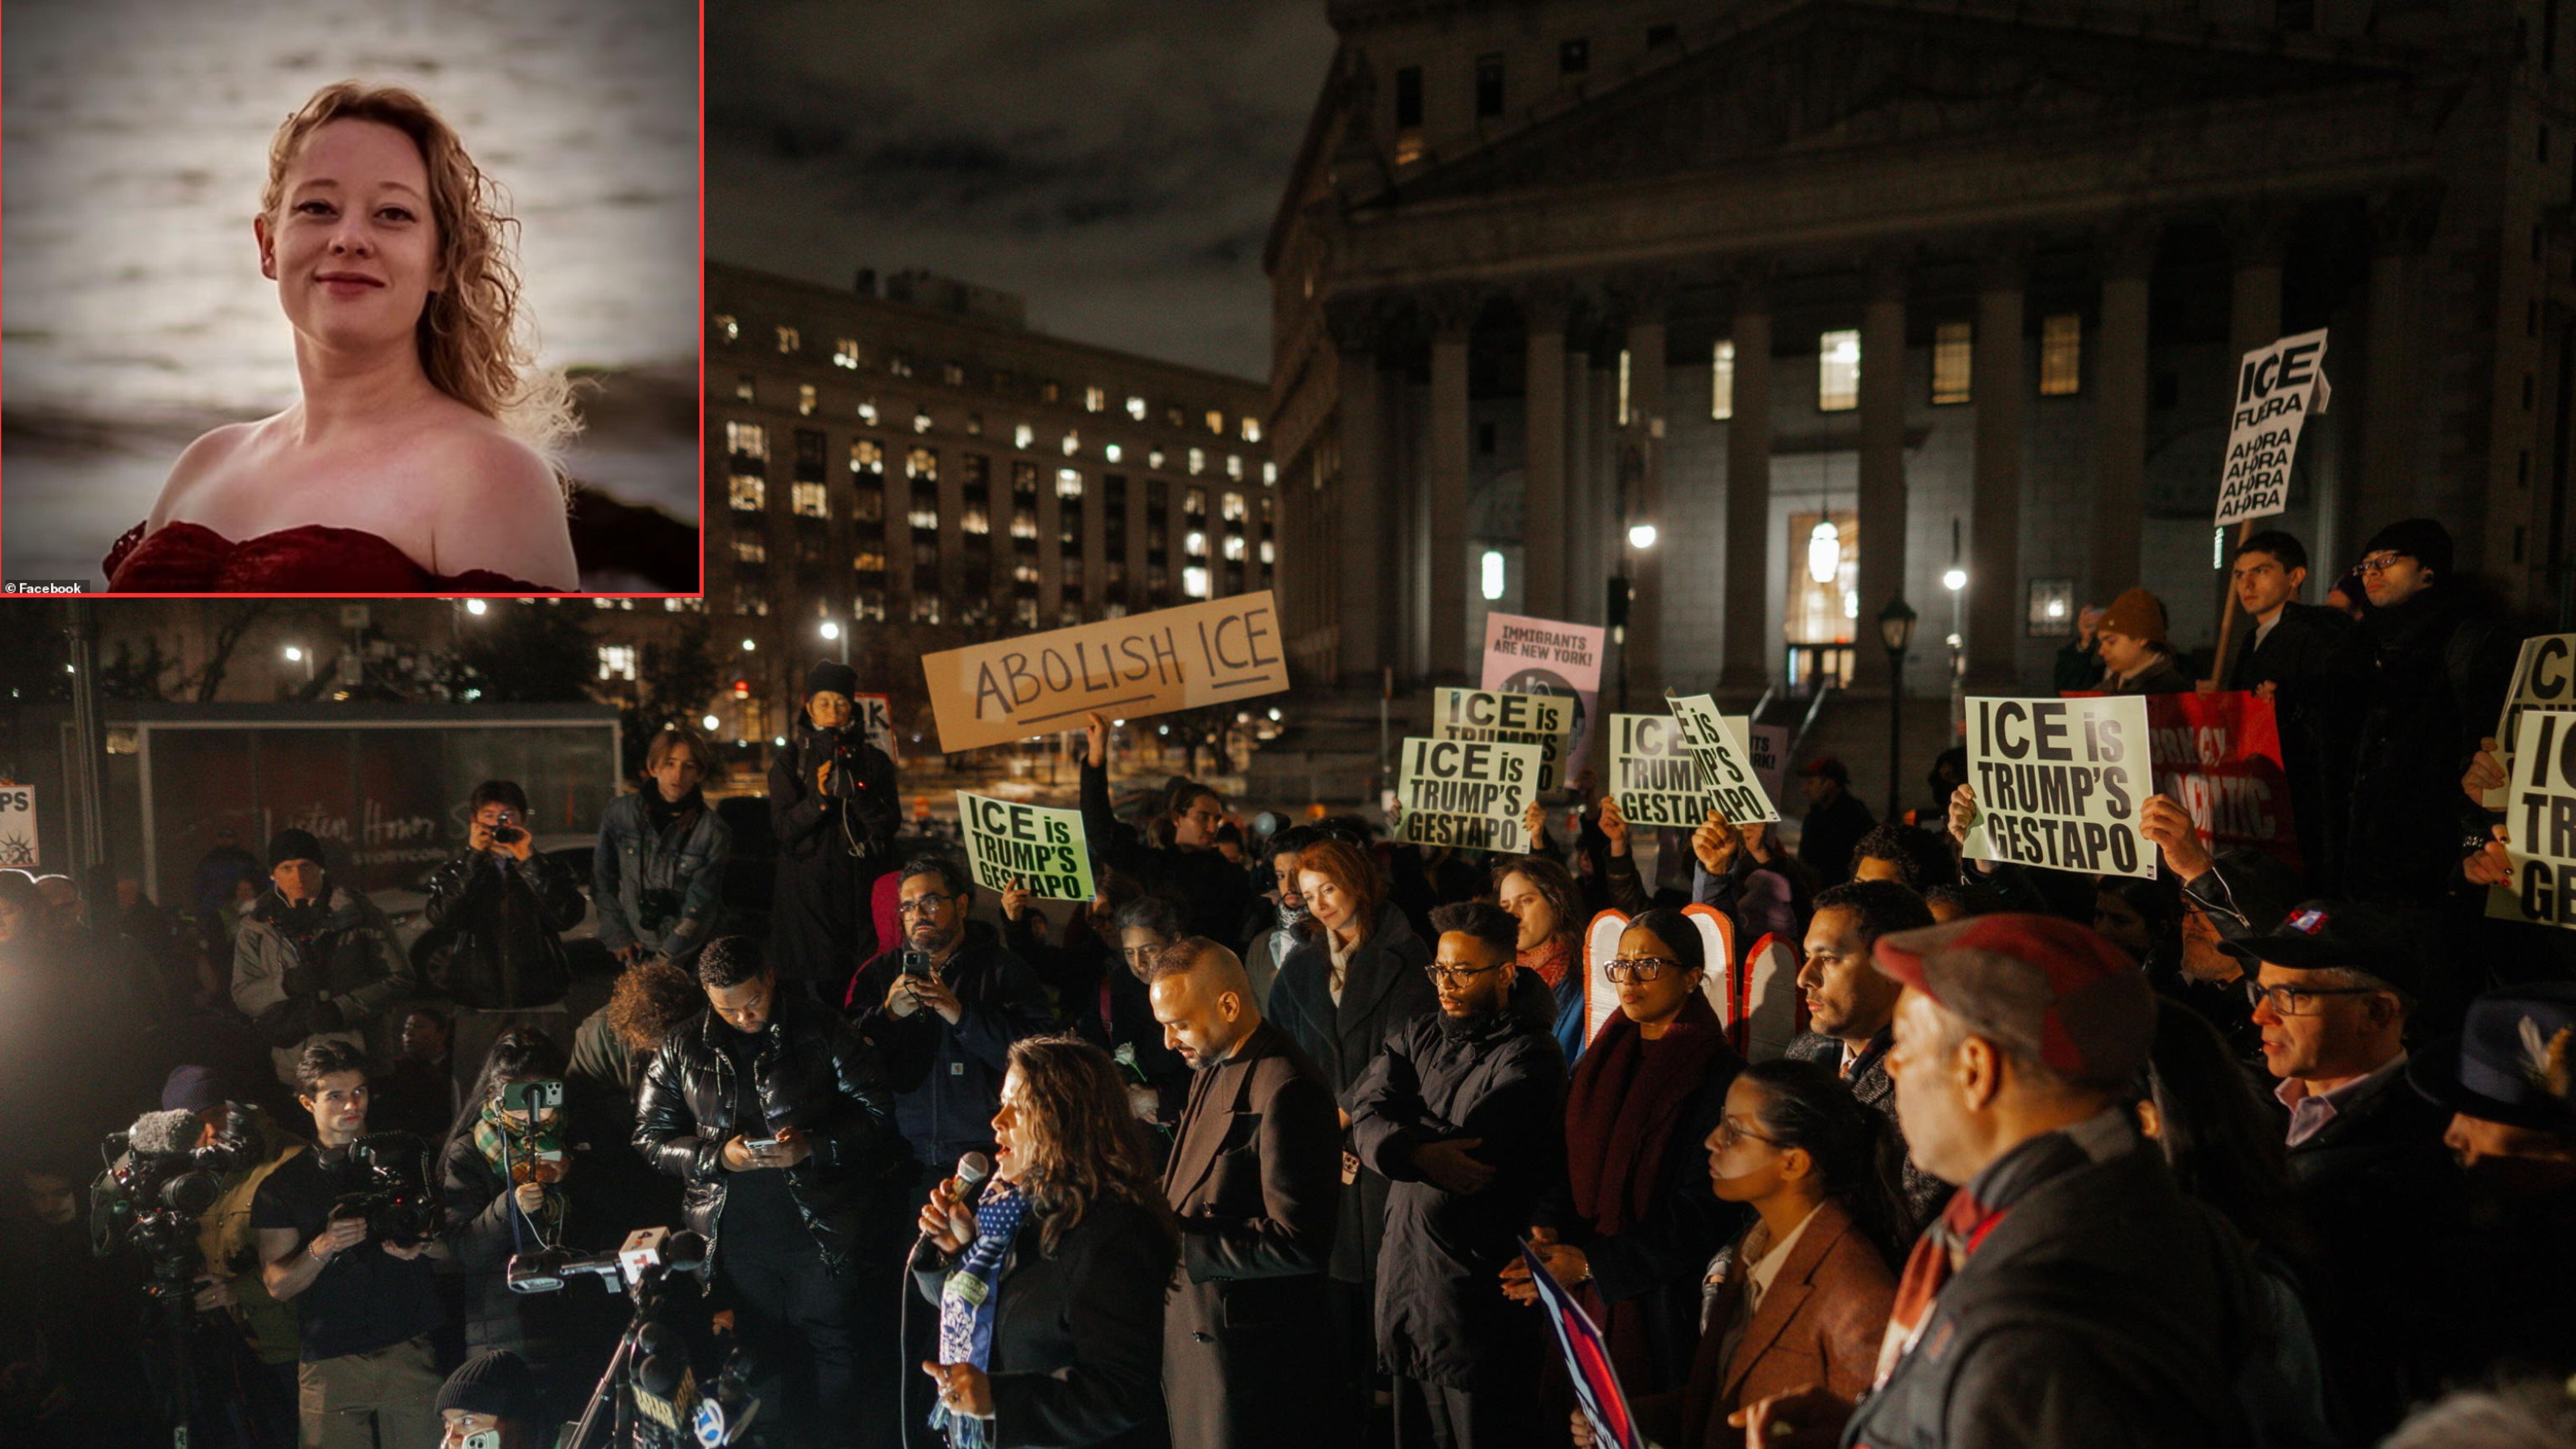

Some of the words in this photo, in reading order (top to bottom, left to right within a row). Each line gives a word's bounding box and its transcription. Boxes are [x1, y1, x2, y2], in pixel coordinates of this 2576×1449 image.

[2240, 341, 2320, 403] ICE
[2234, 393, 2302, 431] FUERA
[2229, 428, 2291, 462] AHORA
[2223, 469, 2283, 500] AHORA
[2226, 449, 2287, 481] AHORA
[2219, 489, 2280, 520] AHORA
[1494, 639, 1518, 655] ARE
[1521, 643, 1550, 659] NEW
[1553, 648, 1593, 667] YORK!
[1502, 625, 1587, 650] IMMIGRANTS
[976, 626, 1184, 719] ABOLISH
[1199, 608, 1279, 677] ICE
[1450, 690, 1528, 729] ICE
[1536, 703, 1559, 731] is
[1690, 707, 1720, 744] is
[1622, 717, 1691, 757] ICE
[1979, 701, 2073, 761] ICE
[2083, 712, 2125, 763] is
[1415, 741, 1492, 780] ICE
[1499, 751, 1524, 783] is
[1410, 778, 1522, 817] TRUMP'S
[1707, 785, 1766, 823] APO
[1977, 761, 2131, 819] TRUMP'S
[968, 796, 1036, 842] ICE
[1044, 815, 1071, 845] is
[1407, 811, 1517, 850] GESTAPO
[972, 830, 1077, 874] TRUMP'S
[1987, 812, 2138, 874] GESTAPO
